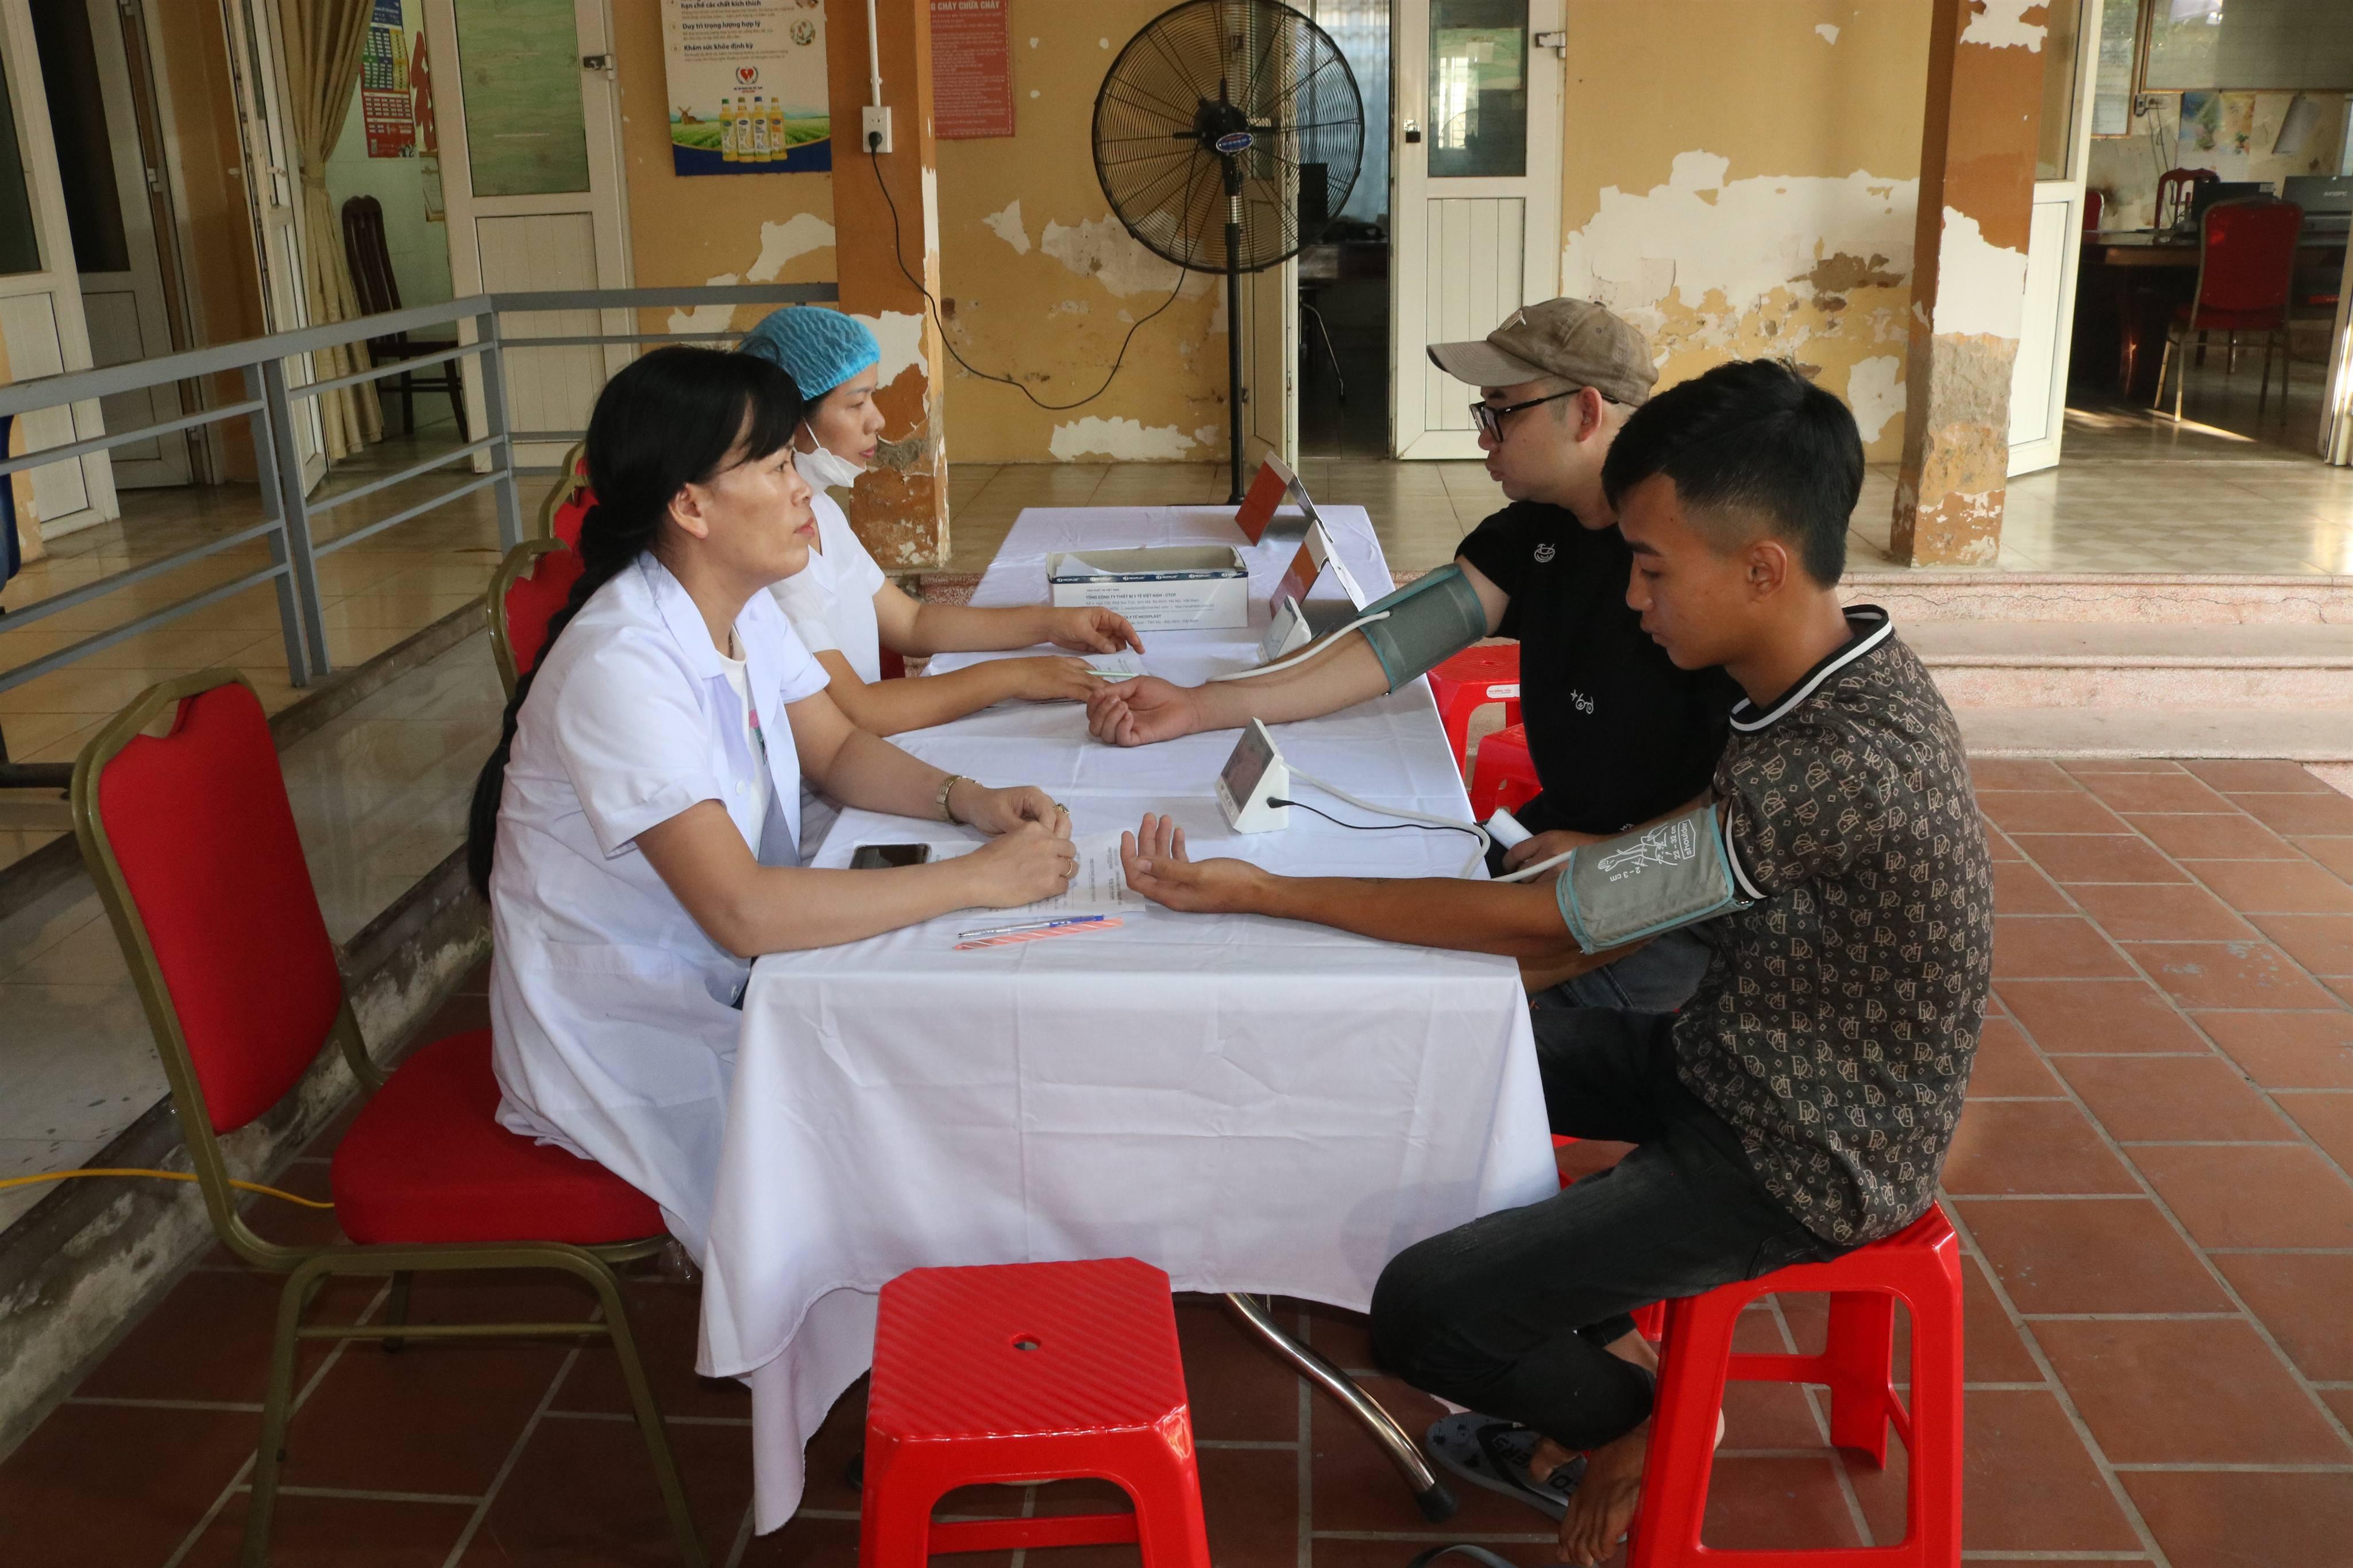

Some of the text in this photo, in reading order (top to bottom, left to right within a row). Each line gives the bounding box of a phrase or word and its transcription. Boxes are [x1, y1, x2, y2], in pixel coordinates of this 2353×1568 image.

[722, 21, 740, 29] lượng
[741, 21, 754, 29] hợp
[1671, 825, 1676, 835] cm
[1671, 834, 1677, 844] 32
[1681, 822, 1692, 855] shoulder
[1673, 849, 1680, 860] 22
[1610, 874, 1622, 882] cm
